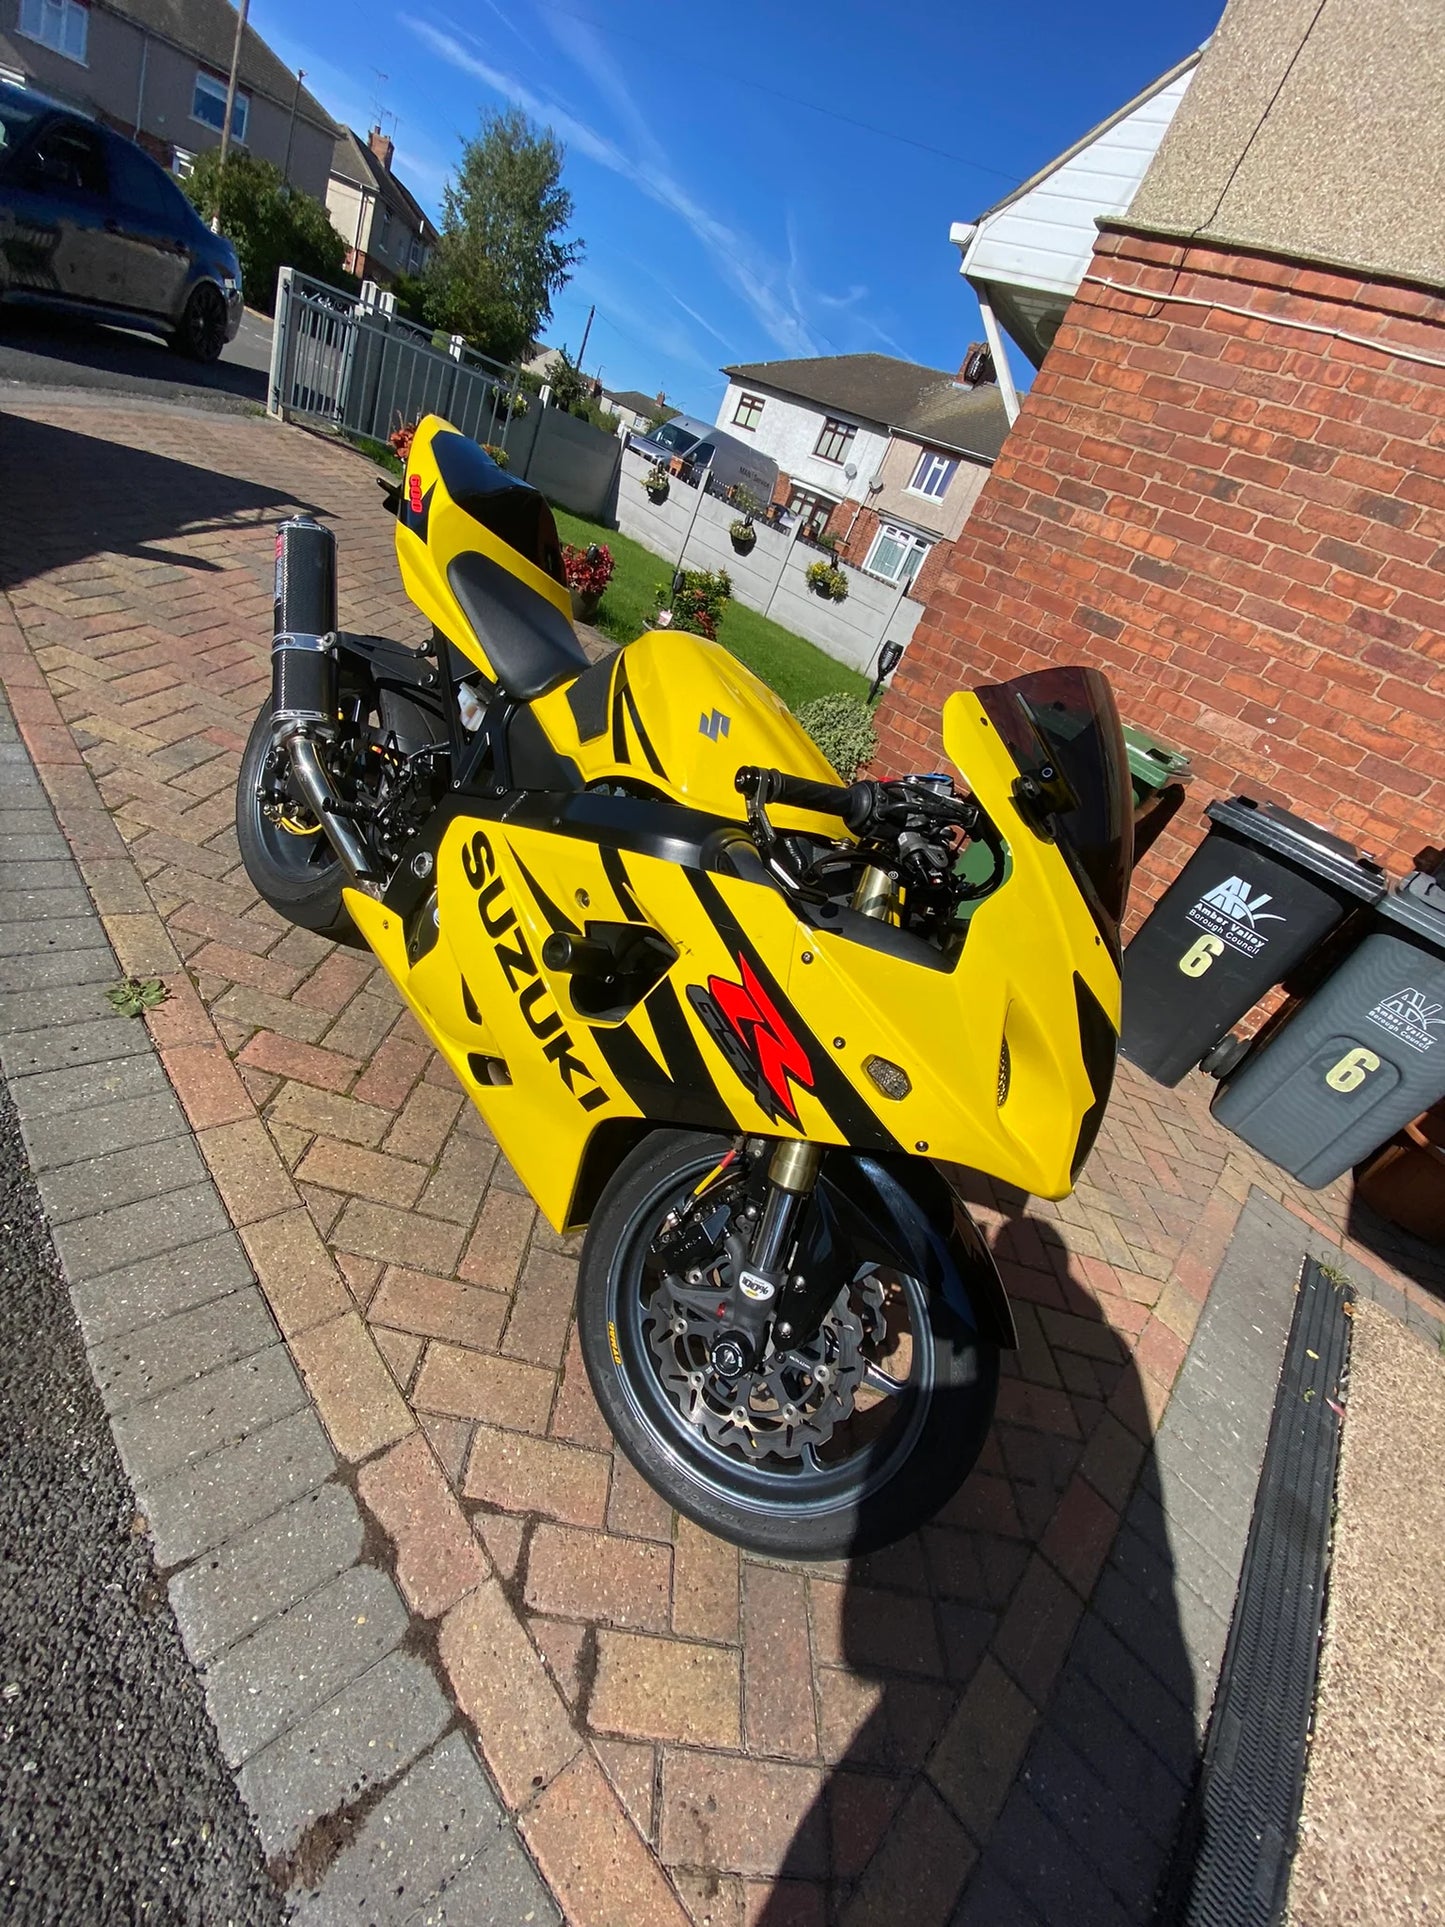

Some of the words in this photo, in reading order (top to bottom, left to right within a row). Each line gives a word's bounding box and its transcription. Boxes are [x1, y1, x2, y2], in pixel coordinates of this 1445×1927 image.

[409, 474, 423, 513] 600
[1188, 908, 1224, 934] Borough
[1225, 931, 1260, 955] Council
[1194, 902, 1229, 926] Amber
[1230, 923, 1266, 948] Valley
[461, 830, 611, 1113] SUZUKI
[1179, 934, 1225, 978] 6
[1368, 1010, 1399, 1032] Borough
[1400, 1030, 1430, 1051] Council
[1373, 1005, 1404, 1026] Amber
[1405, 1025, 1435, 1046] Valley
[1326, 1047, 1380, 1093] 6
[608, 1320, 622, 1365] DYMAG
